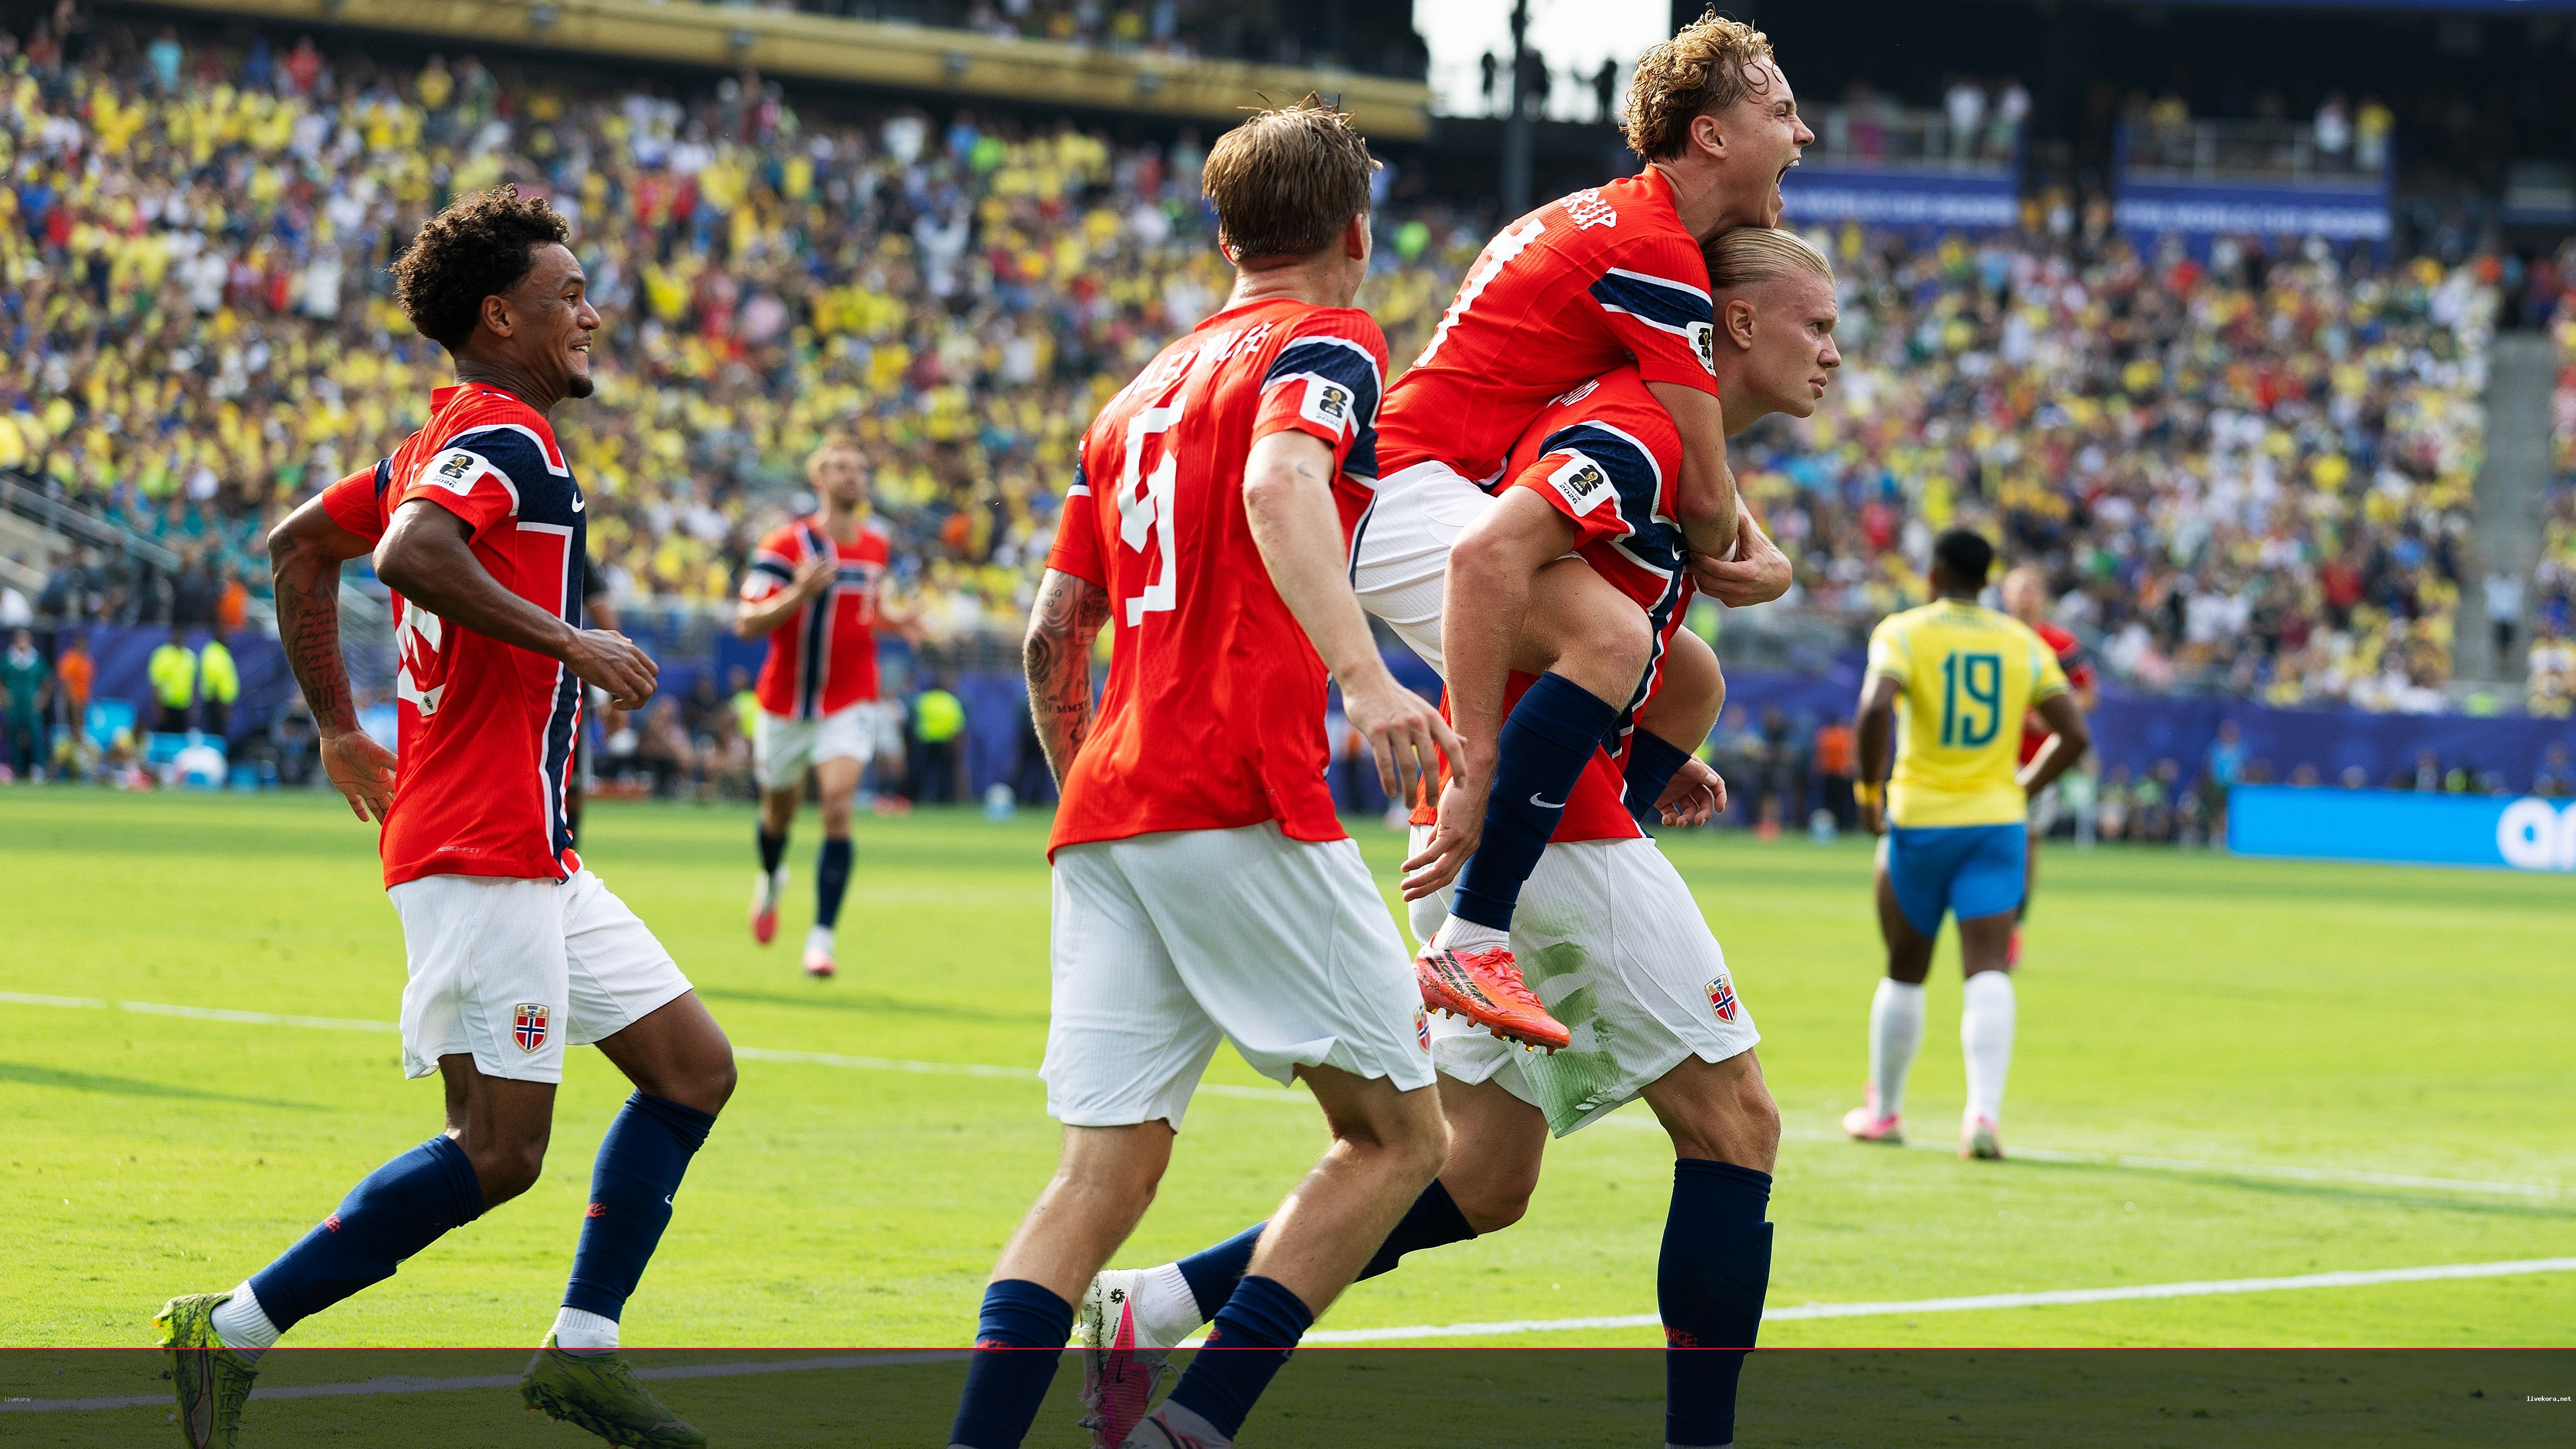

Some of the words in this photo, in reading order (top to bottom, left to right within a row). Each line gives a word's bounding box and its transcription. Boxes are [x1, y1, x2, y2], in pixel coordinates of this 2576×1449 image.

[1559, 484, 1578, 504] 2026
[1563, 482, 1575, 495] WORLD
[1573, 481, 1584, 492] FIFA
[1941, 650, 2001, 747] 19
